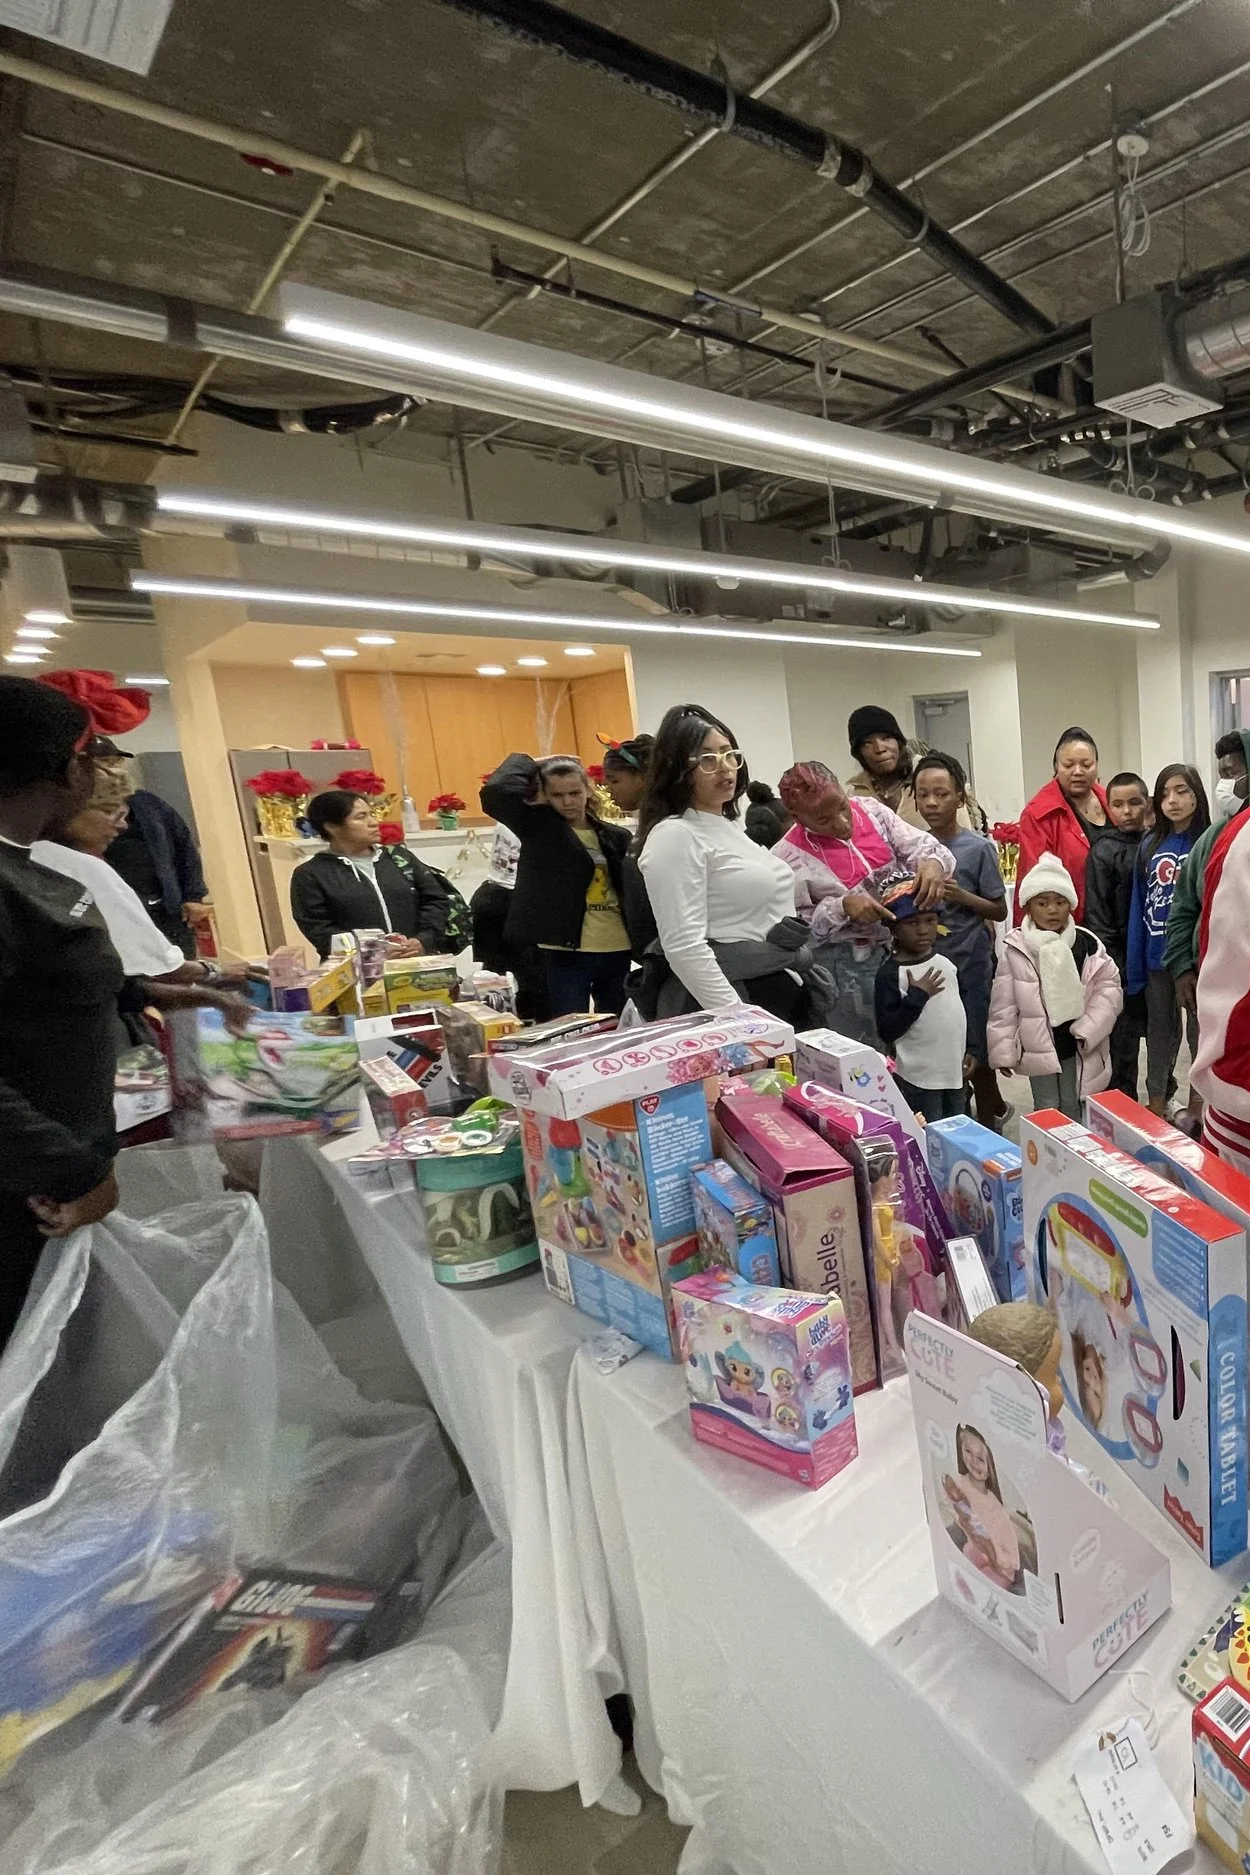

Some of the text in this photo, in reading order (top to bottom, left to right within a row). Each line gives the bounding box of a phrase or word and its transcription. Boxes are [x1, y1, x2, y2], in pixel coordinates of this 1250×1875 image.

[418, 1062, 443, 1089] EVILS
[808, 1314, 830, 1338] baby
[1219, 1351, 1238, 1507] COLOR TABLET
[1092, 1588, 1148, 1651] PERFECTLY
